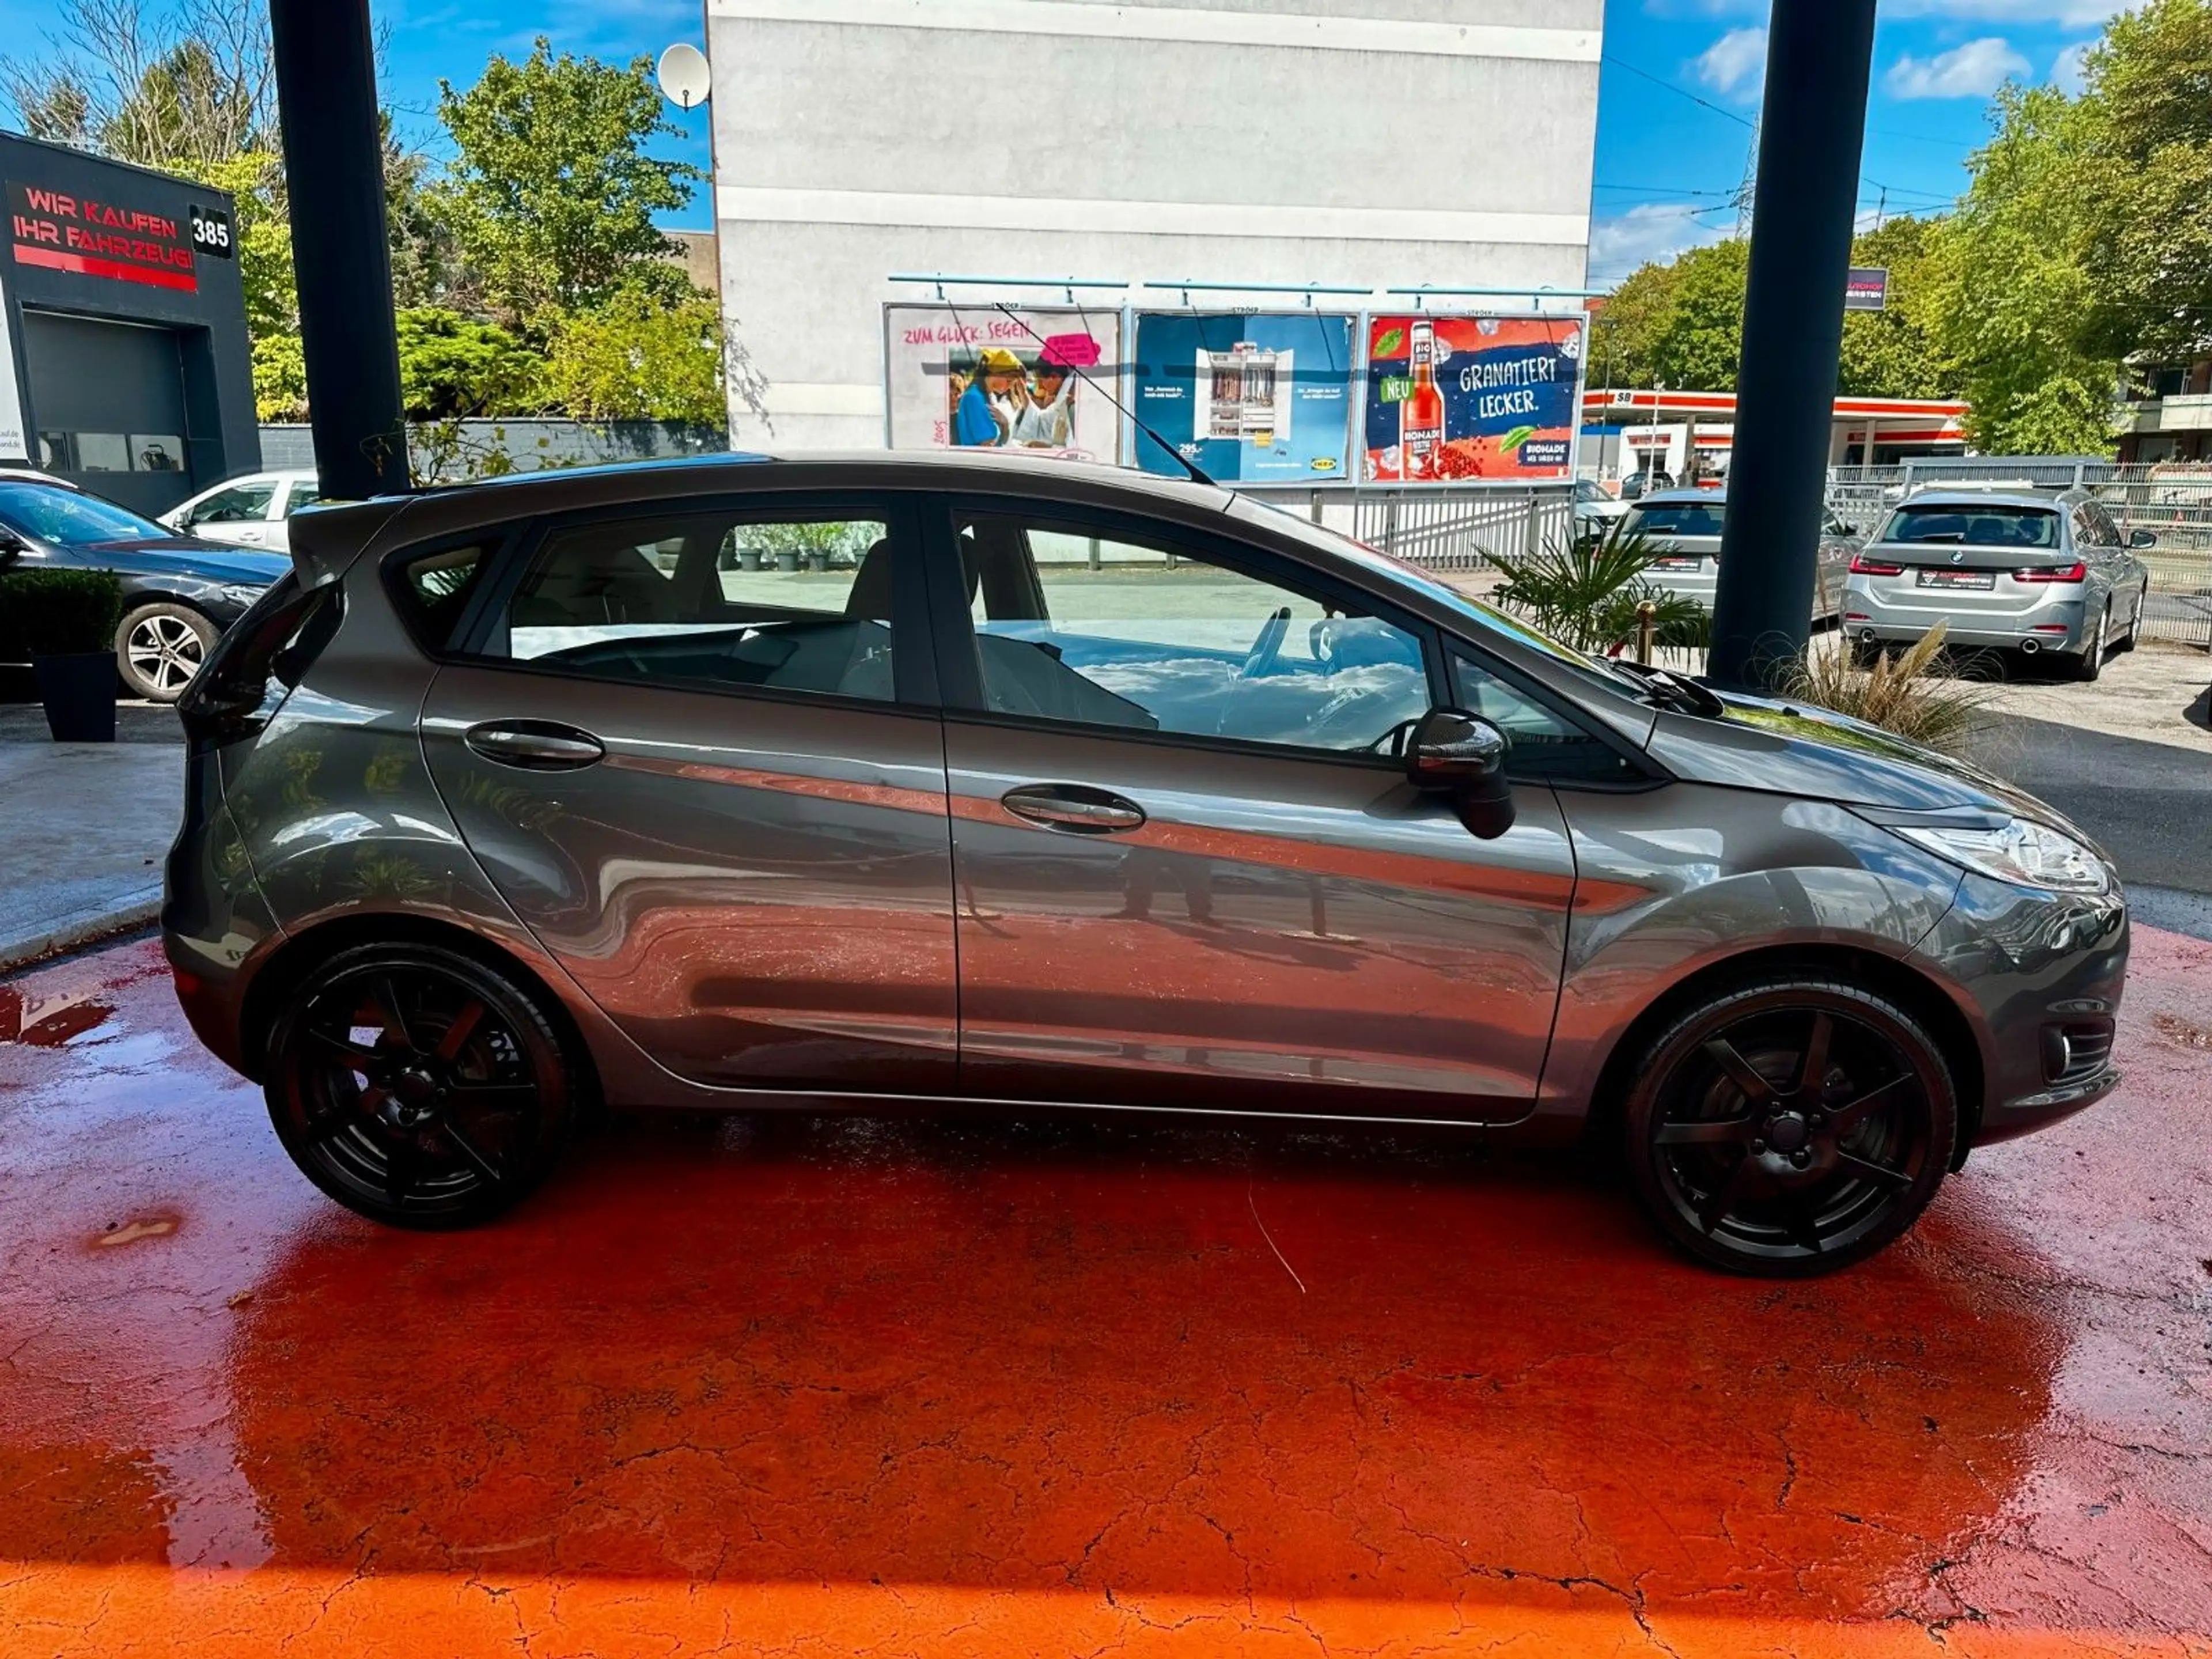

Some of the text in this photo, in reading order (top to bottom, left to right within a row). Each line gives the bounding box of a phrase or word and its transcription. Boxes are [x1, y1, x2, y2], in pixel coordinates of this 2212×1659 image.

[26, 188, 177, 240] WIR KAUFEN
[13, 215, 60, 244] IHR
[192, 218, 229, 248] 385
[904, 327, 933, 344] ZUM
[988, 320, 1030, 339] SEGEN
[1415, 344, 1430, 353] BIO
[1460, 357, 1556, 392] GRANATIERT
[1387, 380, 1410, 399] NEU
[1480, 389, 1539, 418] LECKER.
[1618, 392, 1631, 402] SB
